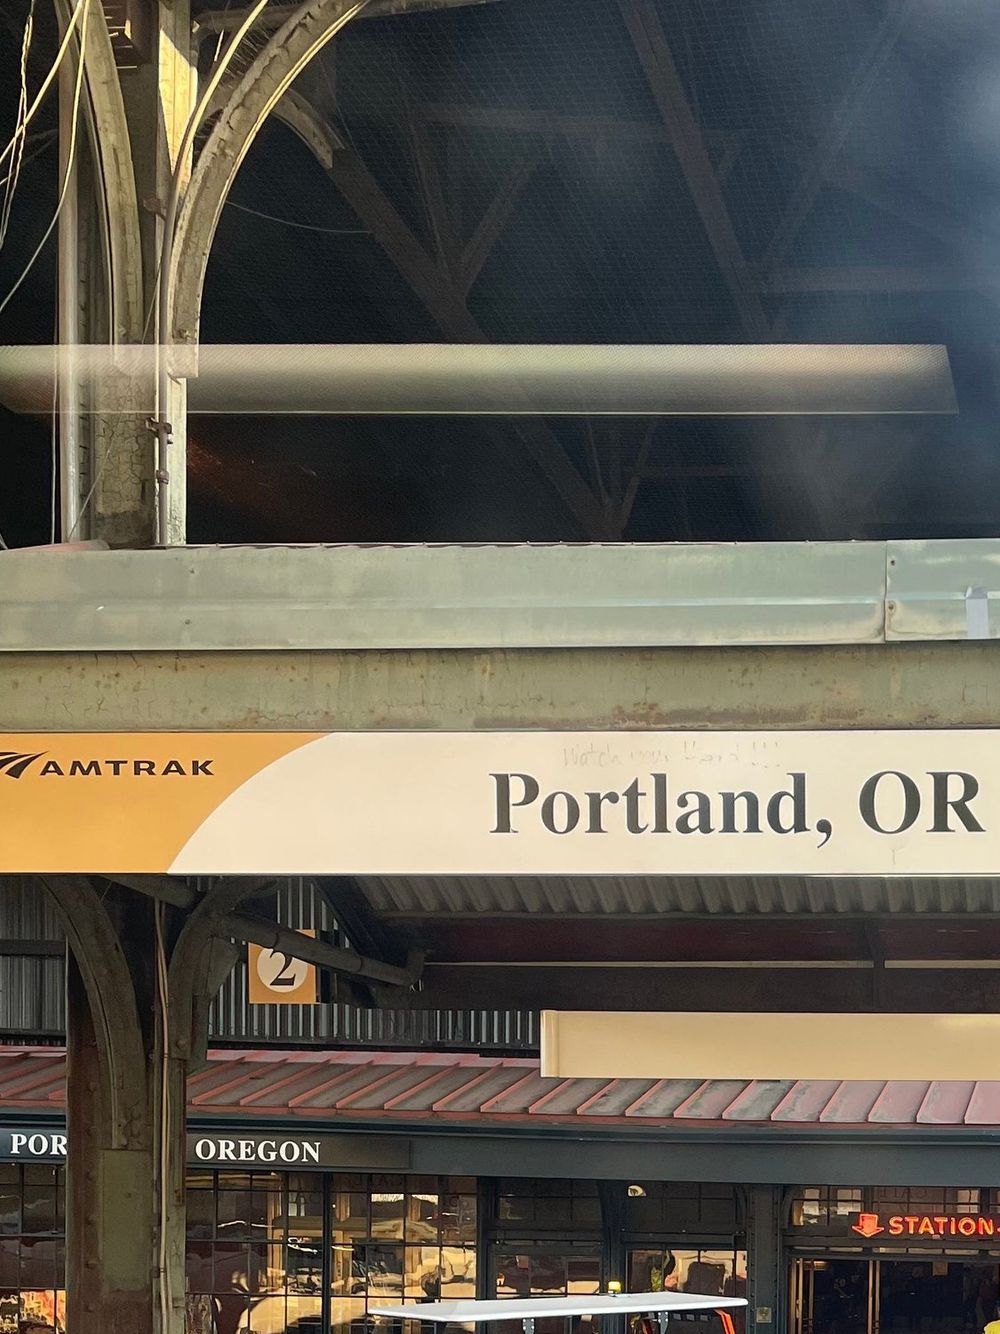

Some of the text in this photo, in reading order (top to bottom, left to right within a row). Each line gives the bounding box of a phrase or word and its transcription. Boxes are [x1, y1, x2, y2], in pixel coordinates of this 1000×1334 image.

[39, 760, 214, 776] AMTRAK
[489, 770, 986, 848] Portland, OR
[270, 950, 296, 986] 2
[195, 1138, 321, 1162] OREGON
[888, 1216, 994, 1236] STATION
